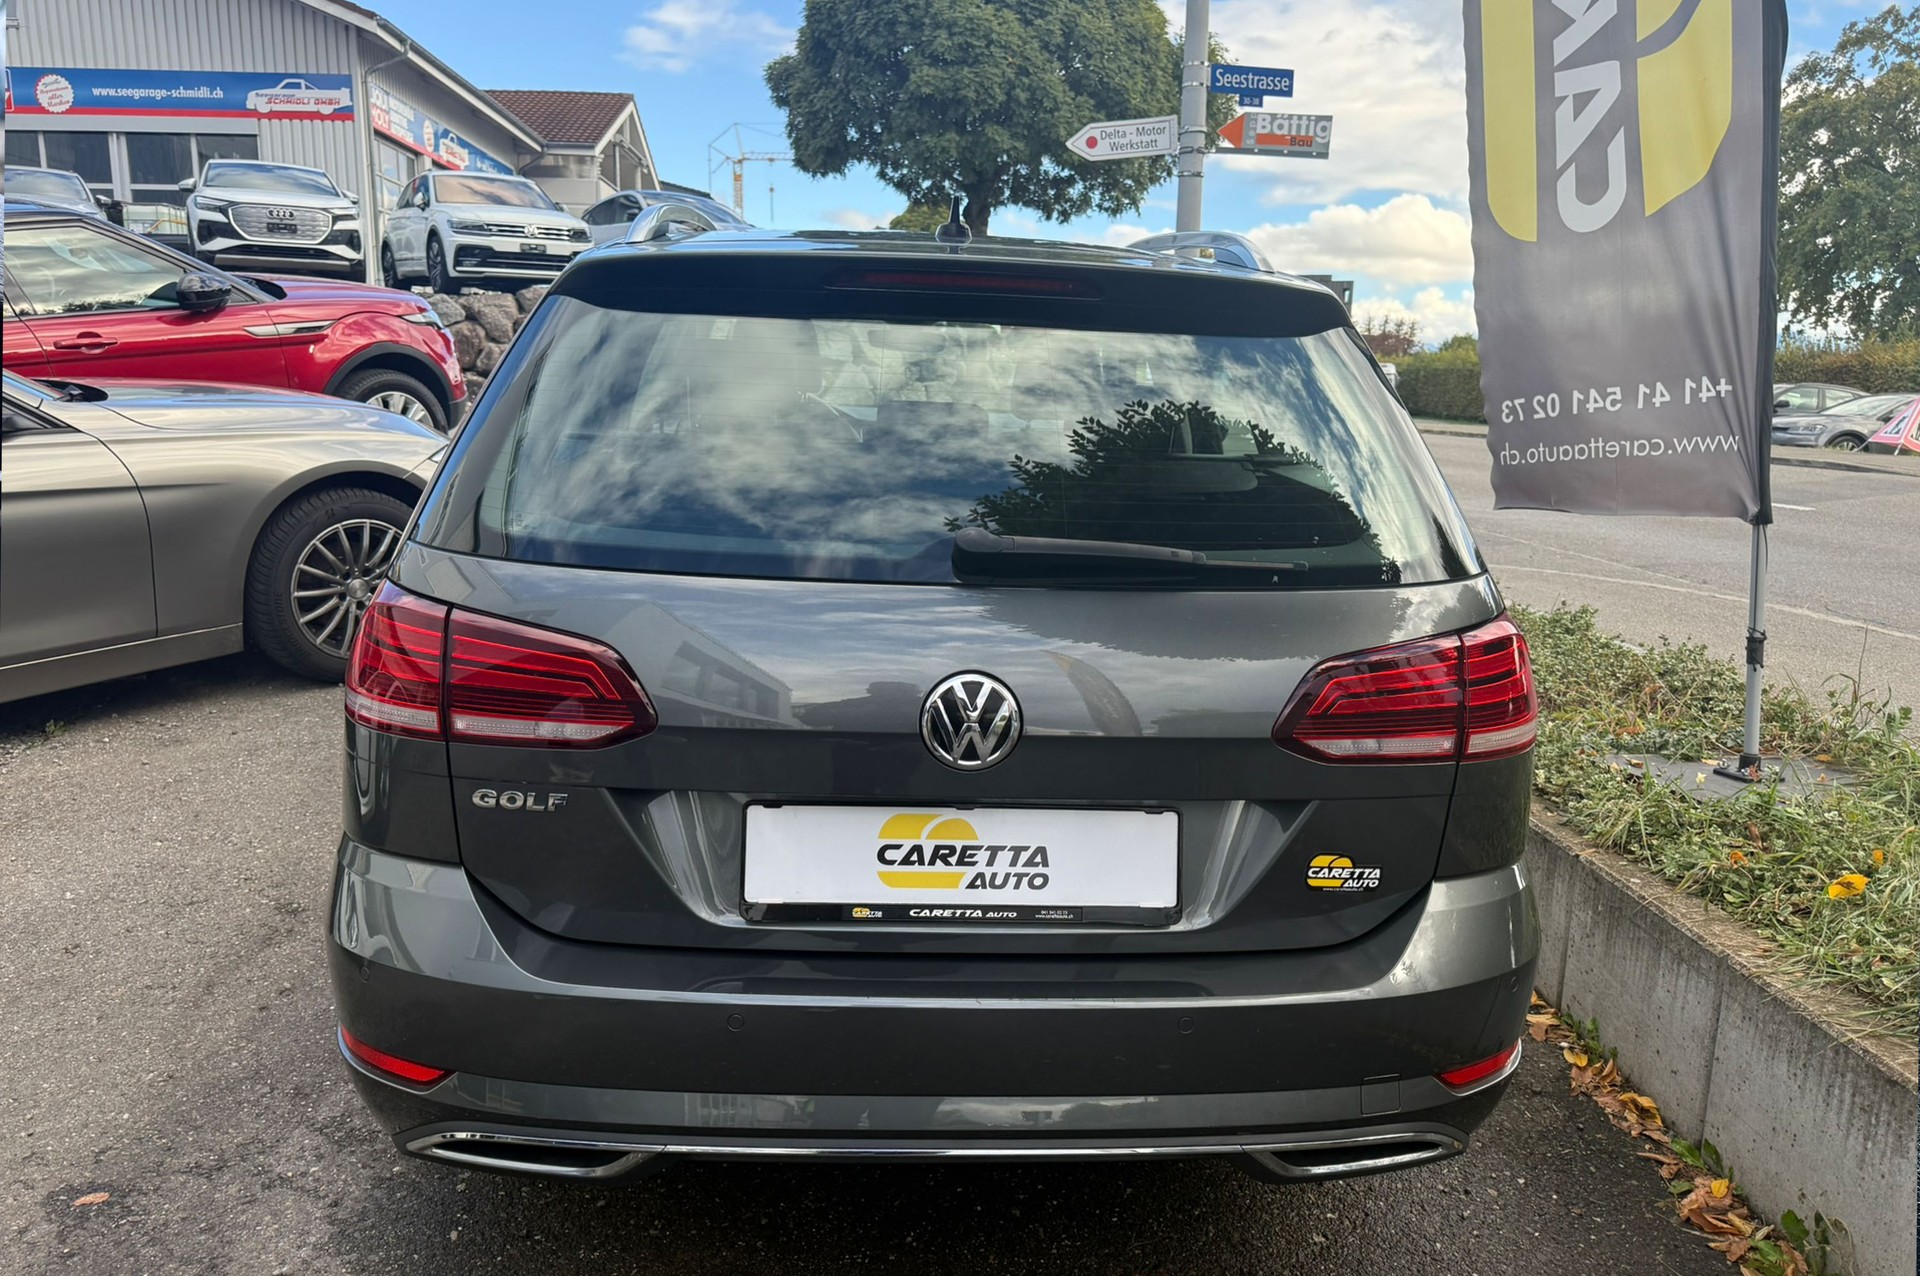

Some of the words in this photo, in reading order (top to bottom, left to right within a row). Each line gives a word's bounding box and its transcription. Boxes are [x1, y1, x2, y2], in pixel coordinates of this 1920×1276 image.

[1215, 69, 1290, 91] Seestrasse
[92, 86, 223, 100] www.seegarage-schmidli.ch
[265, 98, 310, 106] SCHMIDLI
[1100, 128, 1127, 141] Delta
[1136, 126, 1166, 137] Motor
[1256, 113, 1331, 143] Bättig
[1109, 139, 1158, 152] Werkstatt
[1290, 137, 1313, 147] Bau
[472, 788, 568, 812] GOLF
[877, 843, 1050, 868] CARETTA
[1307, 867, 1381, 879] CARETTA
[965, 872, 1050, 891] AUTO
[1342, 879, 1379, 888] AUTO
[909, 908, 983, 918] CARETTA
[985, 910, 1017, 918] AUTO
